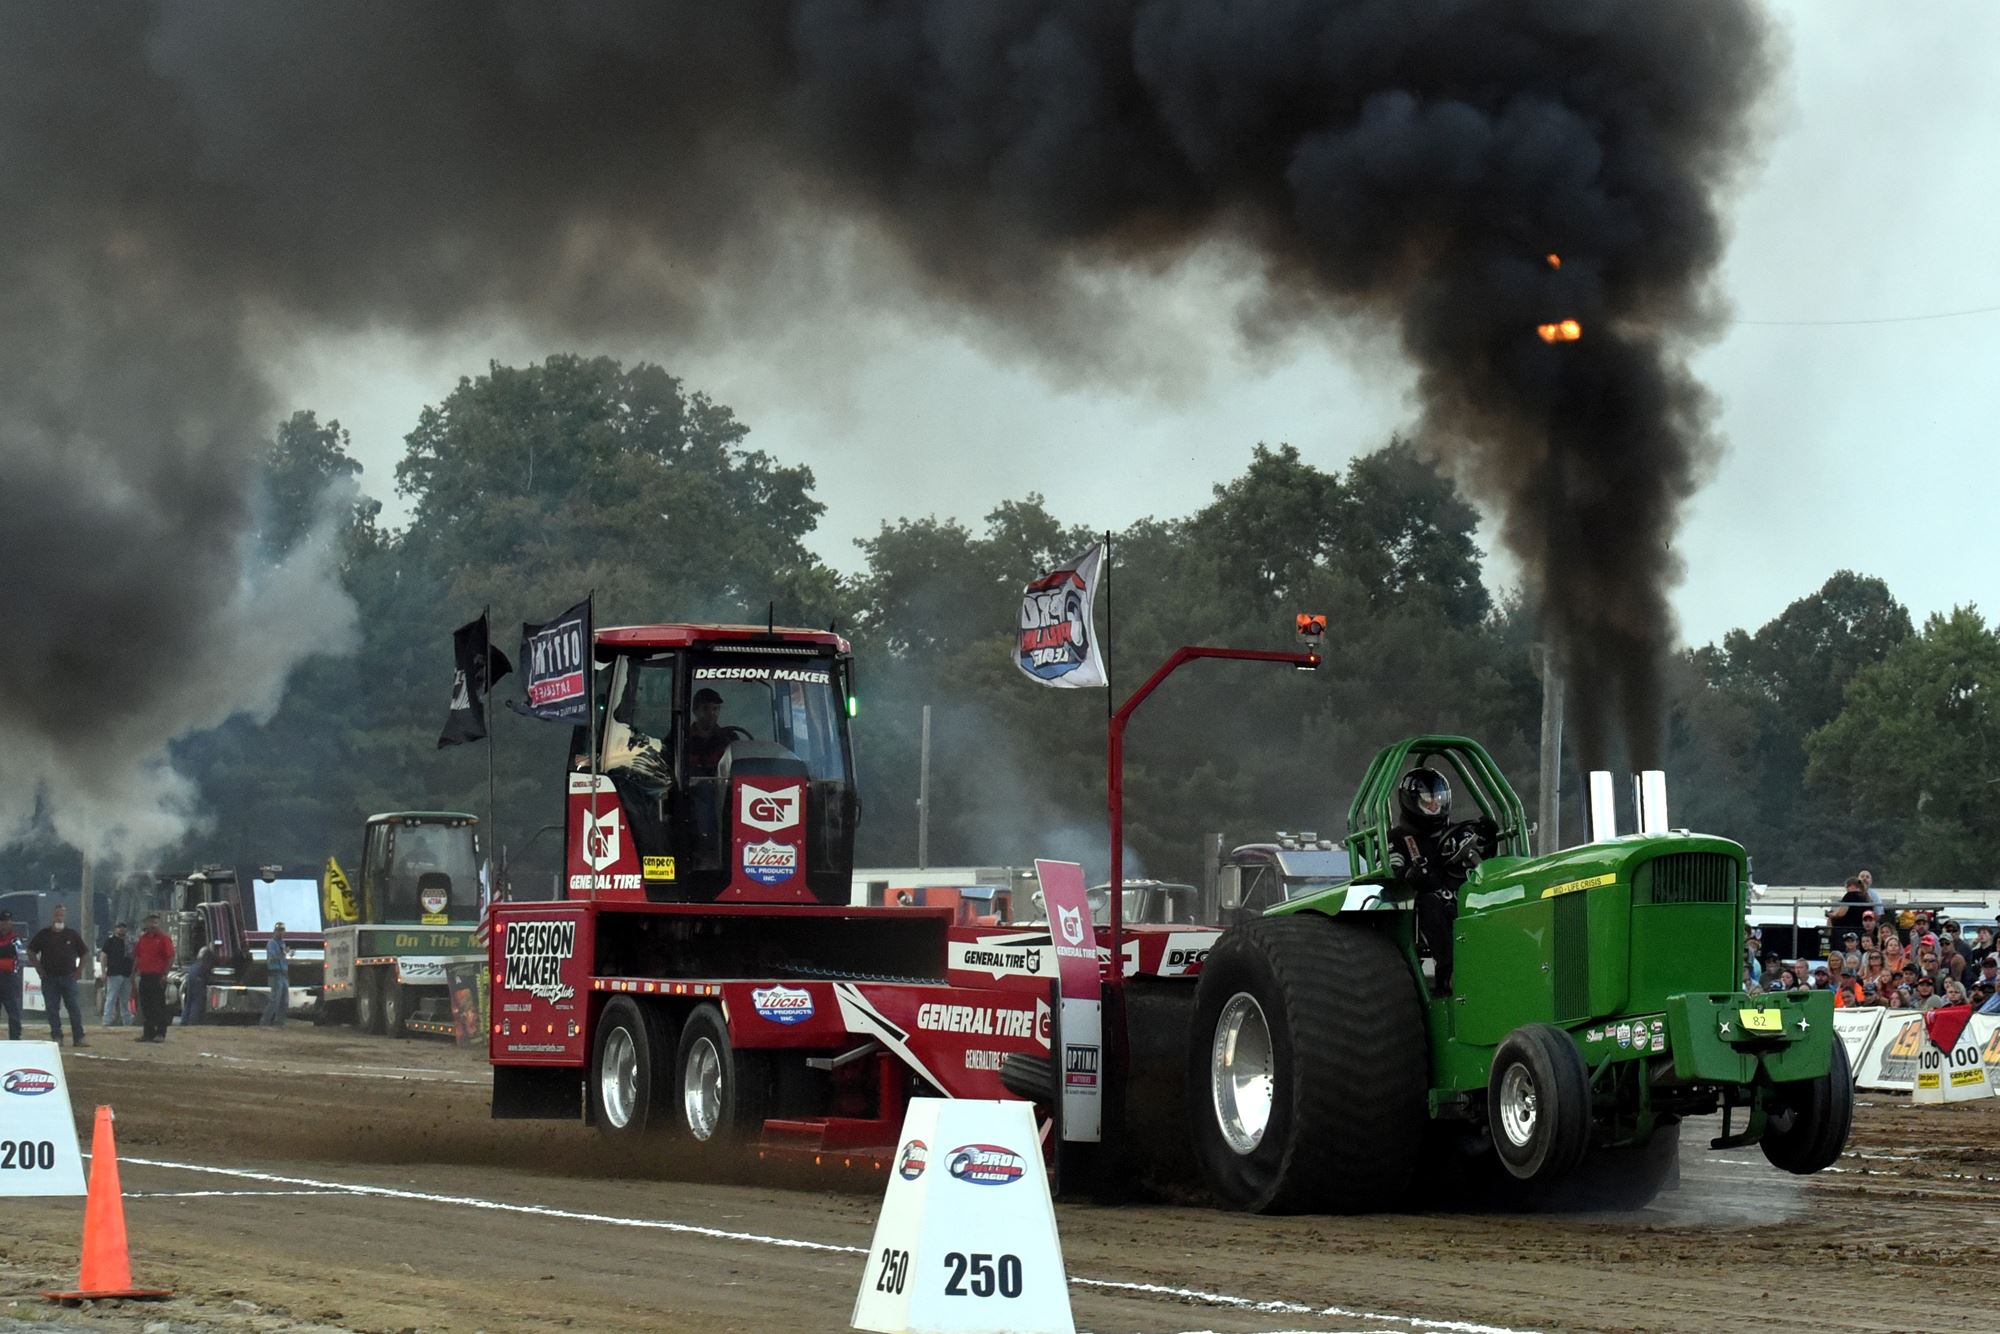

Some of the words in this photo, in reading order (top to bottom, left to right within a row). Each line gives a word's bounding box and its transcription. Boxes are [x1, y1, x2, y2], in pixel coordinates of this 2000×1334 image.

[695, 668, 770, 679] DECISION
[773, 669, 829, 684] MAKER
[749, 797, 793, 823] GT
[748, 854, 793, 866] LUCAS
[613, 874, 642, 889] TIRE
[1567, 882, 1580, 892] LIFE
[1580, 877, 1602, 888] CRISIS
[396, 933, 419, 947] On
[430, 934, 460, 948] The
[505, 921, 576, 958] DECISION
[964, 950, 1005, 967] GENERAL
[1004, 954, 1025, 968] TIRE
[1056, 945, 1083, 957] GENERAL
[504, 955, 561, 989] MAKER
[762, 998, 808, 1008] LUCAS
[917, 1003, 993, 1035] GENERAL
[995, 1008, 1034, 1038] TIRE
[1753, 1016, 1766, 1027] 82
[1067, 1050, 1097, 1070] OPTIMA
[1918, 1051, 1940, 1070] 100
[1948, 1046, 1979, 1068] 100
[1, 1140, 55, 1170] 200
[974, 1151, 1013, 1167] PRO
[971, 1172, 1010, 1181] LEAGUE
[876, 1248, 909, 1295] 250
[944, 1252, 1023, 1299] 250
